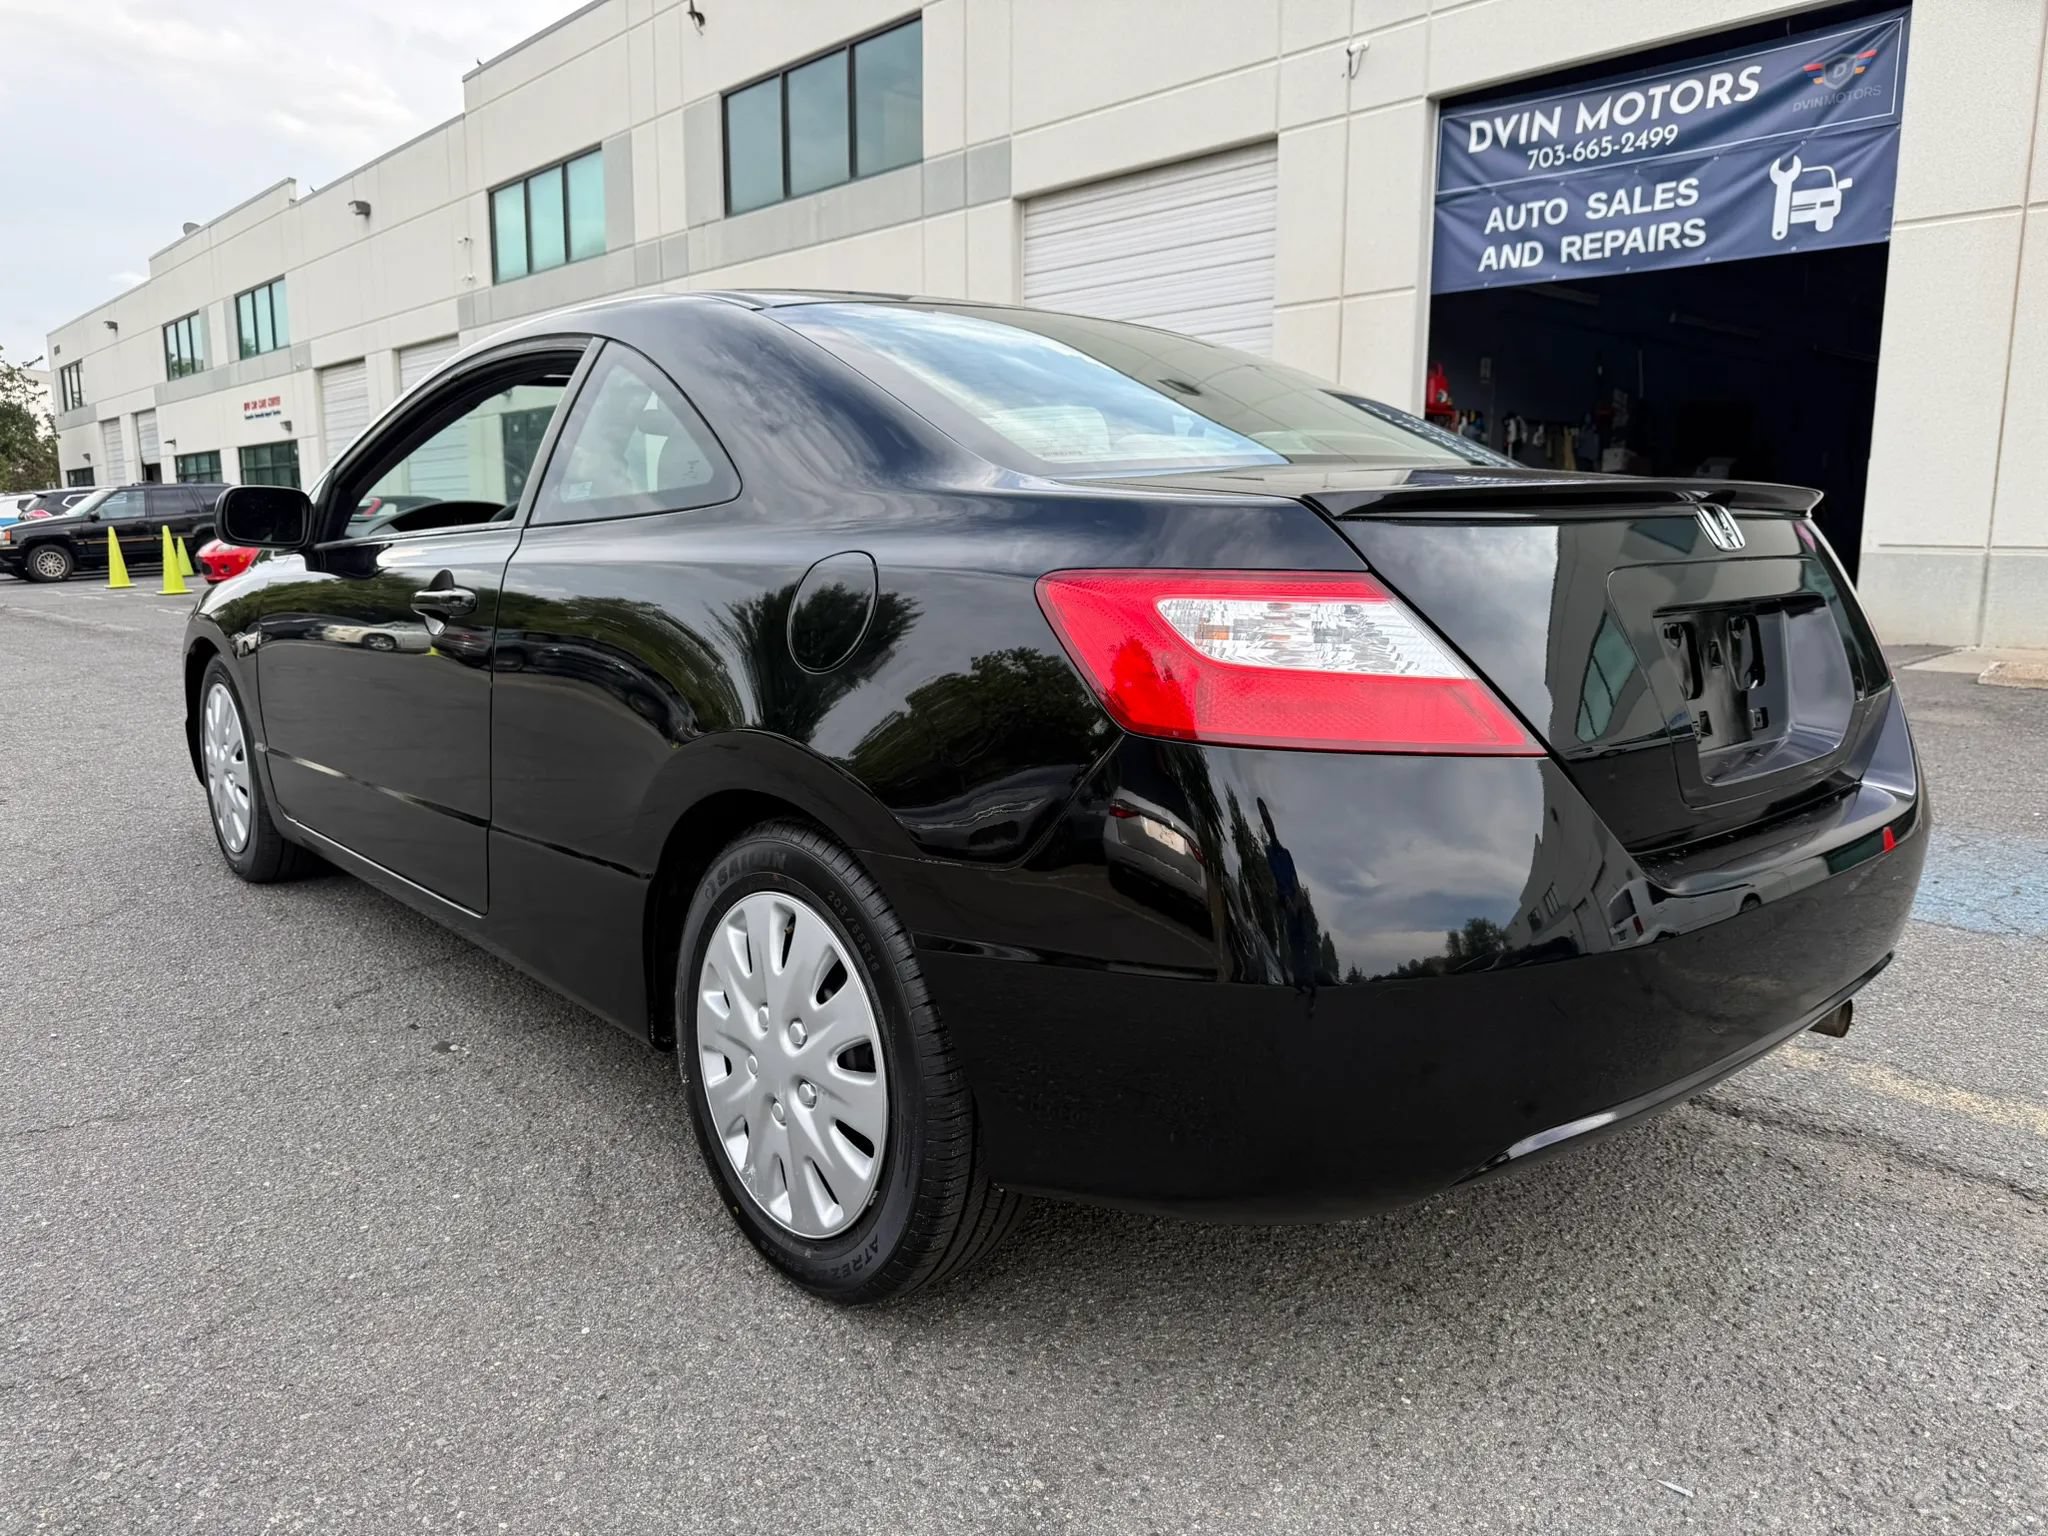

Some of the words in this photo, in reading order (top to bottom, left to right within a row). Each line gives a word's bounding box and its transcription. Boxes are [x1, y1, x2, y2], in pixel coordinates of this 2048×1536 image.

[1467, 106, 1562, 154] DVIN
[1574, 66, 1763, 135] MOTORS
[1526, 124, 1679, 171] 703-665-2499
[1484, 197, 1569, 236] AUTO
[1584, 177, 1700, 220] SALES
[1477, 240, 1544, 273] AND
[1560, 218, 1707, 264] REPAIRS
